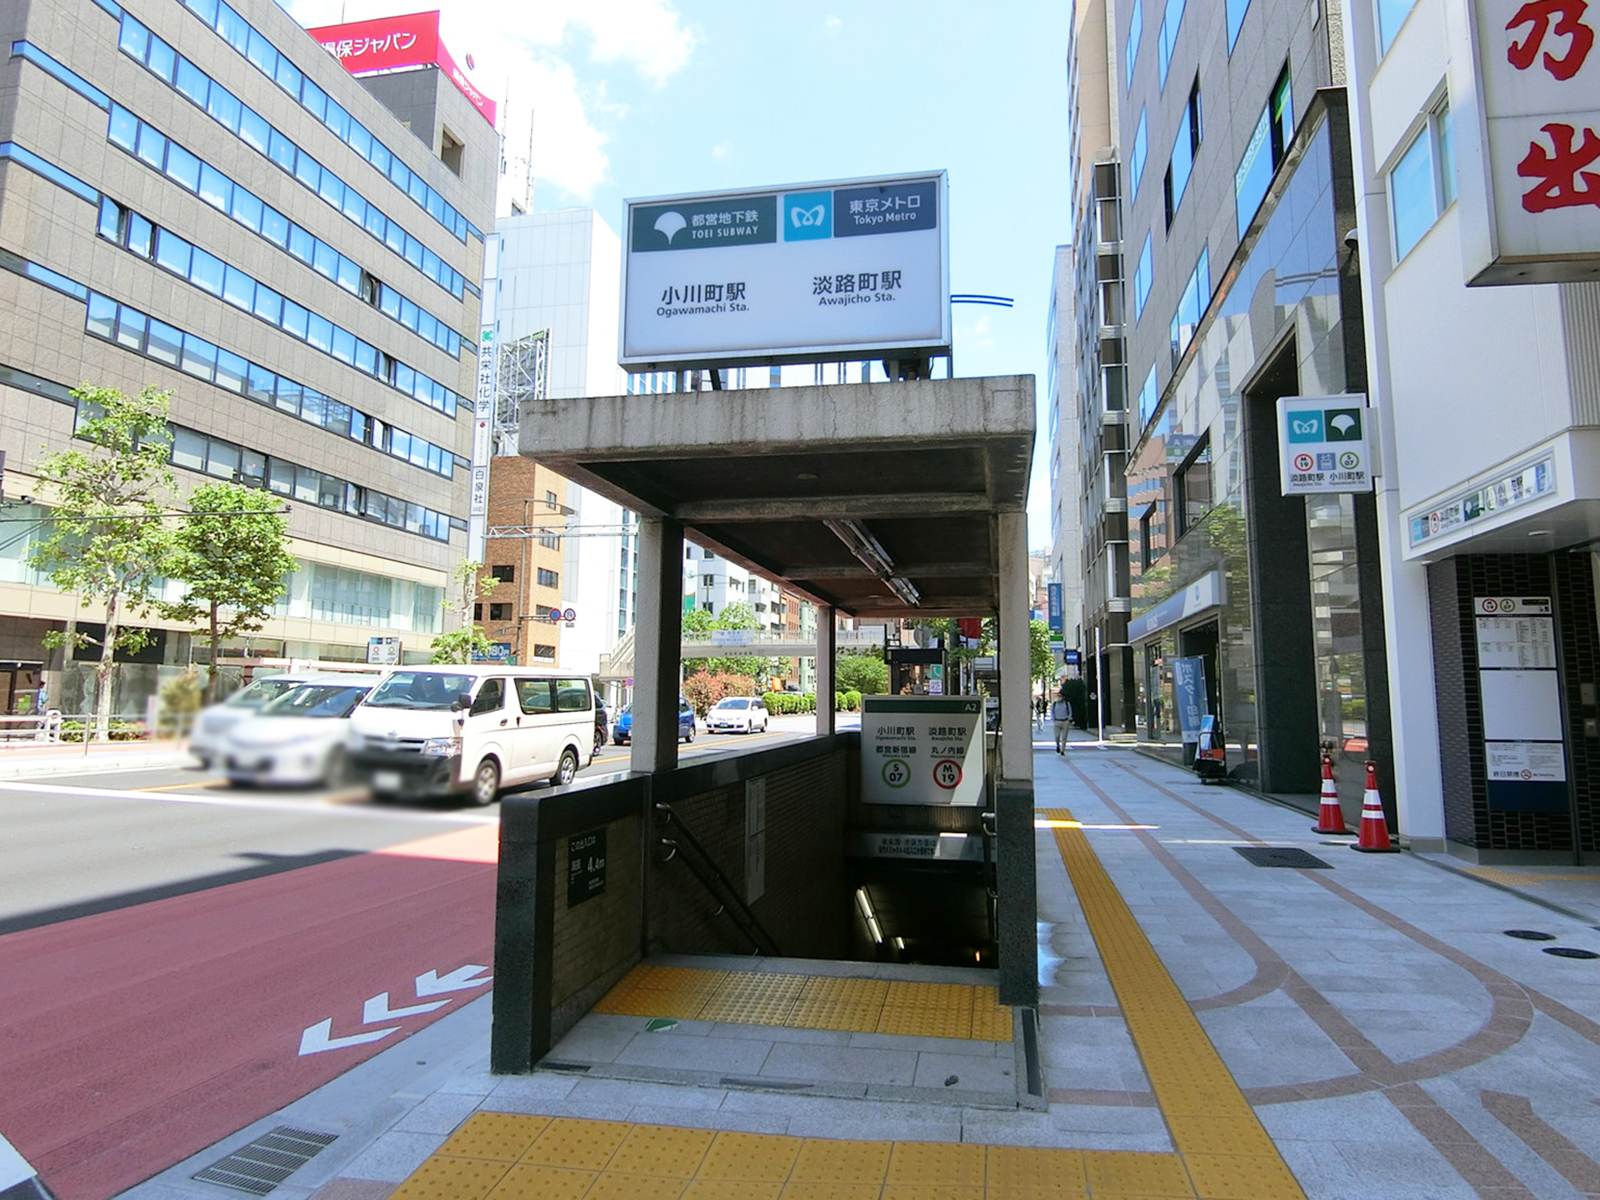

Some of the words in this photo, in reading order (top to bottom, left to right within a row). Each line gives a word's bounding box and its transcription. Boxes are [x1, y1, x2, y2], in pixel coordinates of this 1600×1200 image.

[849, 195, 921, 214] 東京メトロ
[692, 209, 759, 227] 都営地下鉄
[854, 214, 884, 226] Tokyo
[885, 212, 917, 222] Metro
[692, 229, 713, 239] TOEI
[717, 225, 759, 237] SUBWAY
[812, 270, 902, 295] 淡路町駅
[661, 282, 746, 305] 小川町駅
[819, 293, 871, 307] Awajicho
[874, 292, 896, 302] Sta.
[656, 303, 726, 318] Ogawamachi
[729, 302, 750, 312] Sta.
[478, 346, 493, 413] 共栄社化学
[1290, 473, 1325, 482] 淡路町駅
[1330, 472, 1365, 481] 小川町駅
[878, 727, 915, 735] 小川町駅
[928, 727, 967, 736] 淡路町駅
[876, 746, 917, 754] 都営新宿線
[931, 747, 964, 755] 丸ノ内線
[893, 763, 899, 772] S
[889, 773, 903, 782] 07
[942, 774, 955, 782] 19
